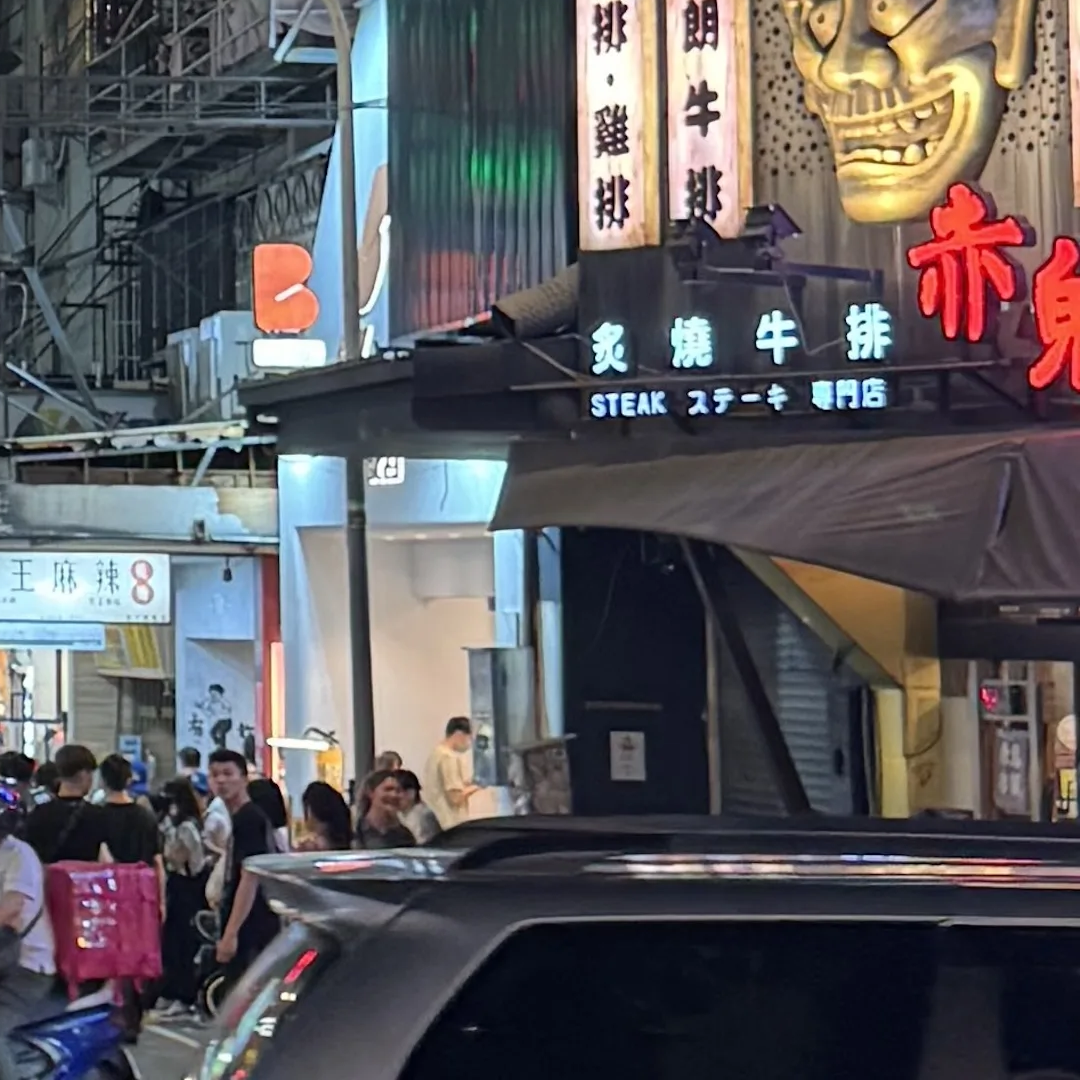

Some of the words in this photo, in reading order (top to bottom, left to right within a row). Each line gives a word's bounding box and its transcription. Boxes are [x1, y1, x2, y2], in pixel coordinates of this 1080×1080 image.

[592, 303, 893, 375] 炙燒牛排
[591, 391, 667, 418] STEAK
[688, 383, 788, 417] ステーキ
